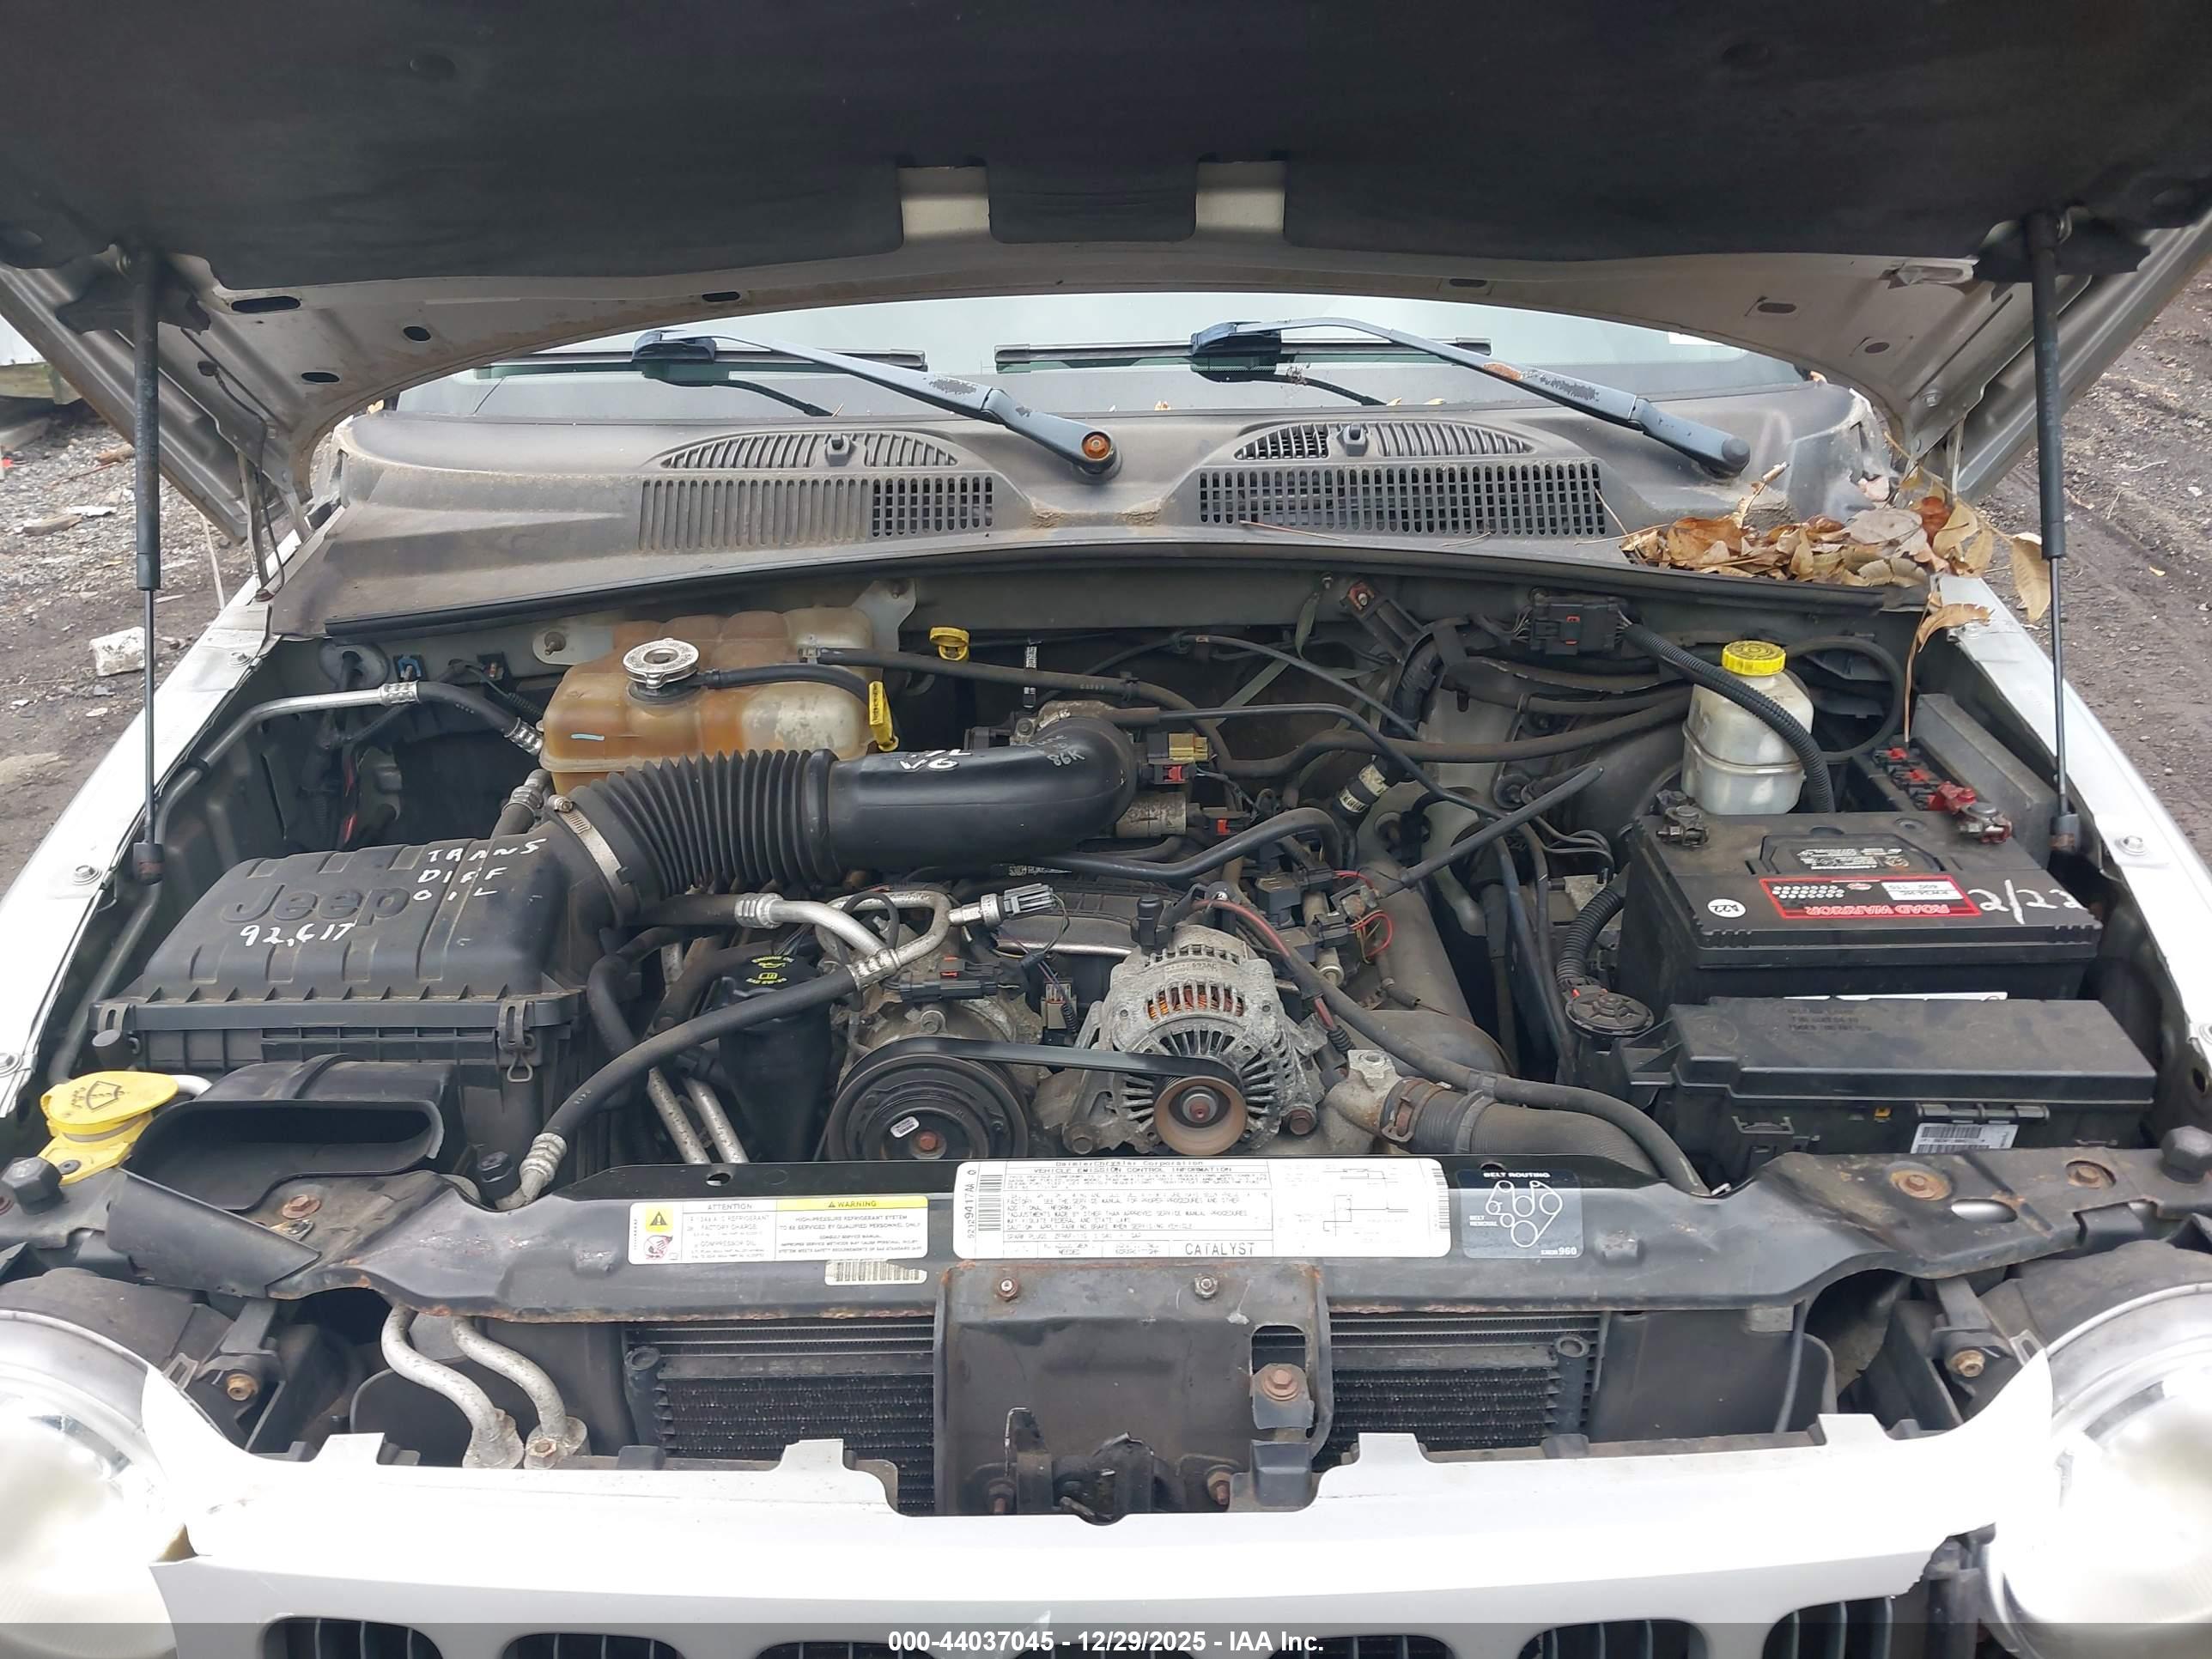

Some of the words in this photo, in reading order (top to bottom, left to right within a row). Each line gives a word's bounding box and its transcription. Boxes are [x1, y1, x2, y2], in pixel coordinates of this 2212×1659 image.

[899, 757, 960, 773] V6
[1046, 749, 1086, 767] 86K
[427, 838, 548, 864] TRANS
[412, 887, 499, 902] OIL
[221, 883, 411, 926] Jeep
[1805, 904, 1894, 915] WARRIOR
[1894, 903, 1951, 915] ROAD
[1185, 1243, 1255, 1255] CATALYST
[1559, 1247, 1577, 1255] 960
